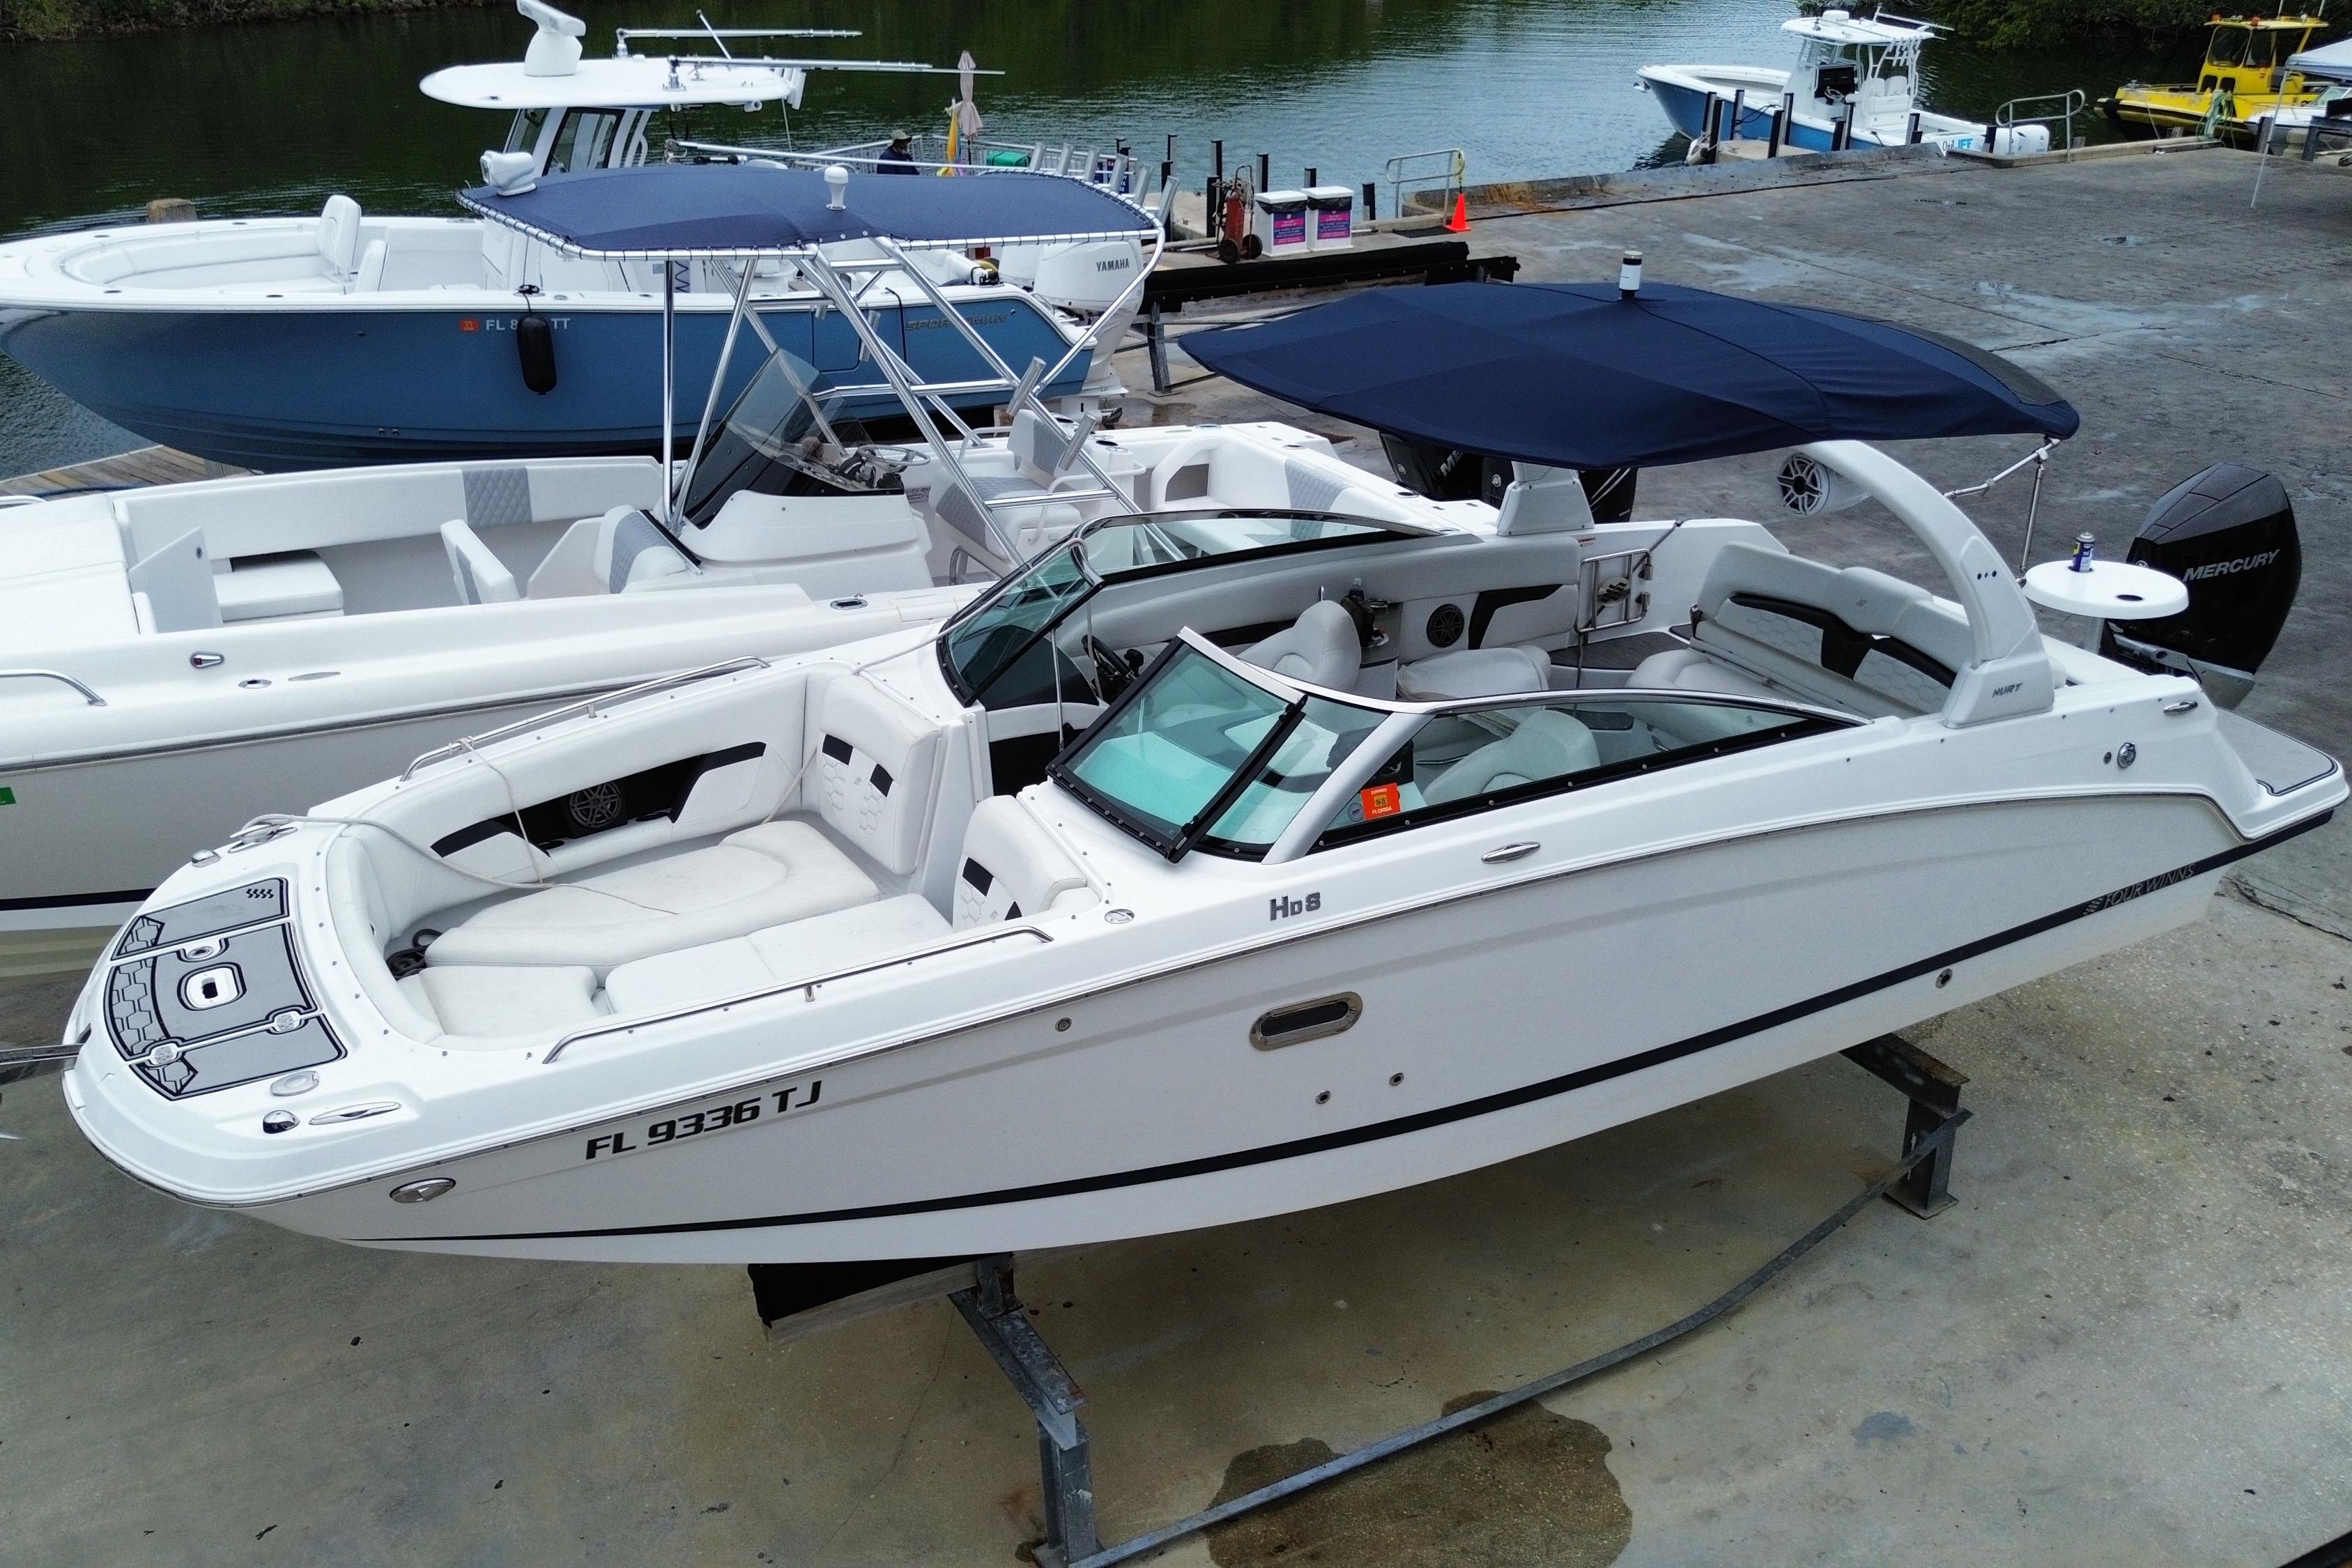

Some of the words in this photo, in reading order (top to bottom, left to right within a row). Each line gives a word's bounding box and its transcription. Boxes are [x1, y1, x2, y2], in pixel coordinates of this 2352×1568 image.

[1096, 258, 1130, 272] YAMAHA
[486, 319, 506, 330] FL
[551, 317, 571, 330] TT
[2182, 548, 2281, 582] MERCURY
[2102, 883, 2142, 909] FOUR
[2145, 863, 2196, 893] WINNS
[585, 1132, 636, 1160] FL
[647, 1096, 762, 1146] 9336
[771, 1079, 822, 1114] TJ
